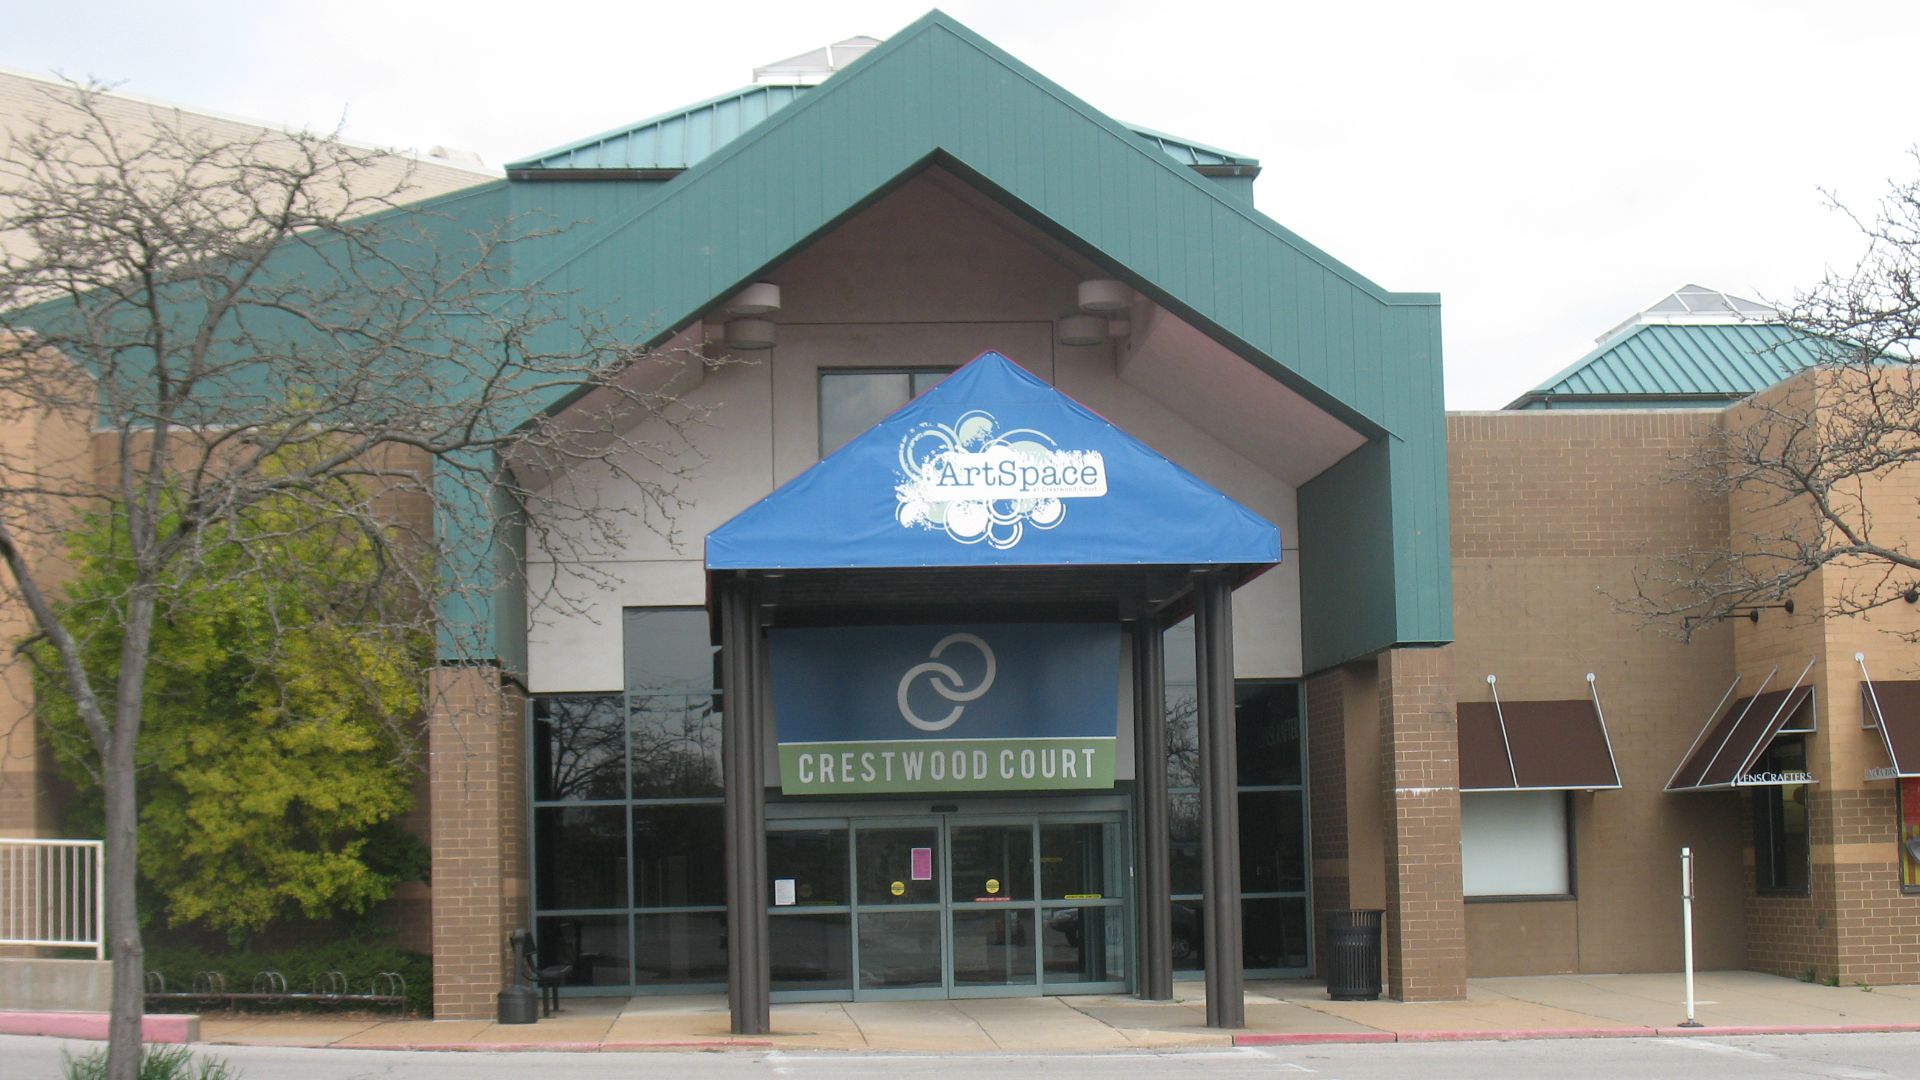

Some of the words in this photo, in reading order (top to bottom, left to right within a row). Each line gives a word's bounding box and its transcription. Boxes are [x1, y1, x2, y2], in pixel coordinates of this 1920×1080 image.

[936, 460, 1098, 492] ArtSpace
[799, 750, 988, 784] CRESTWOOD
[1000, 748, 1096, 780] COURT
